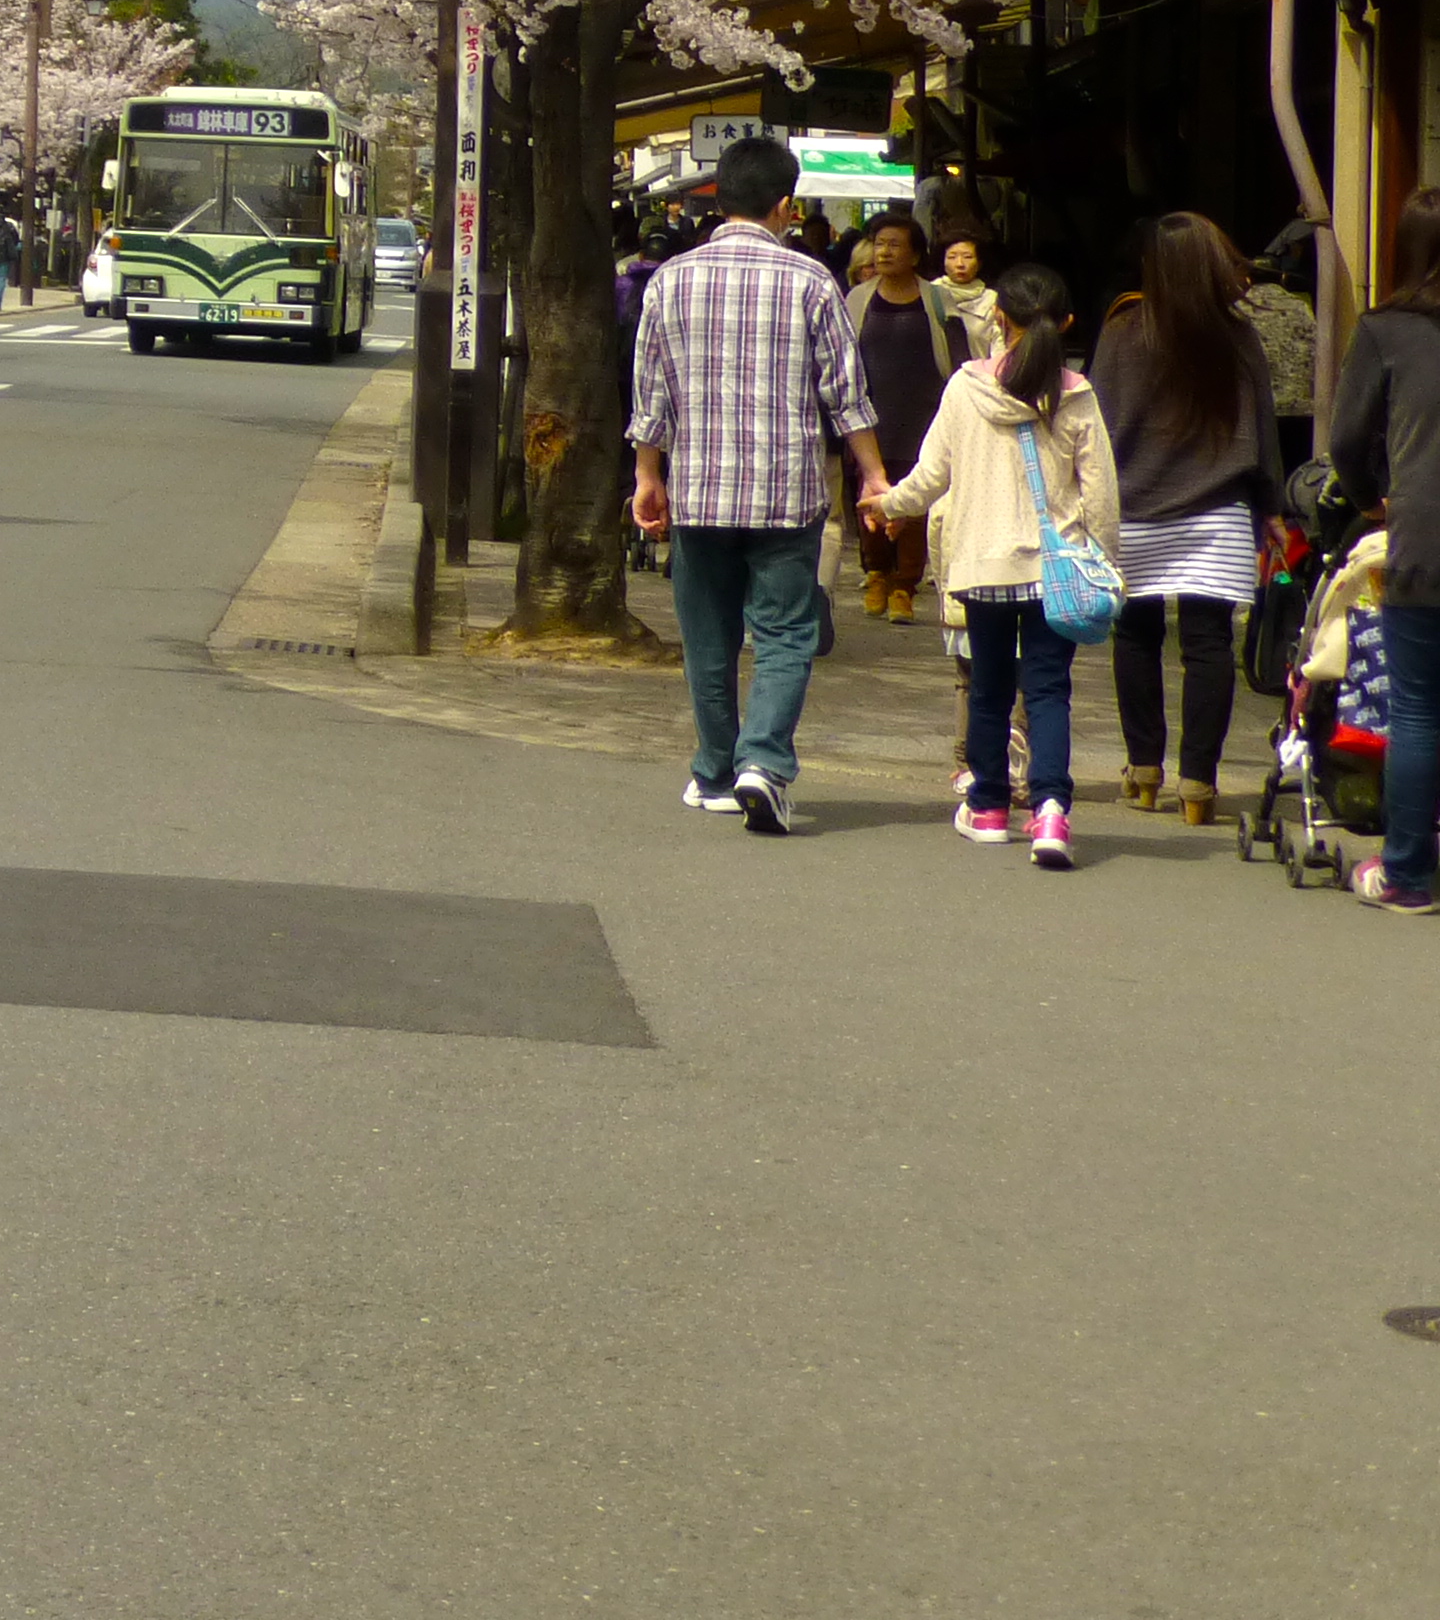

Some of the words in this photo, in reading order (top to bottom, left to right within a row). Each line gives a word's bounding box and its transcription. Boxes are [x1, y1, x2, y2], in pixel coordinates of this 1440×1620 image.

[254, 112, 286, 134] 93
[458, 202, 476, 257] 桜まつり
[455, 278, 474, 360] 五木茶屋
